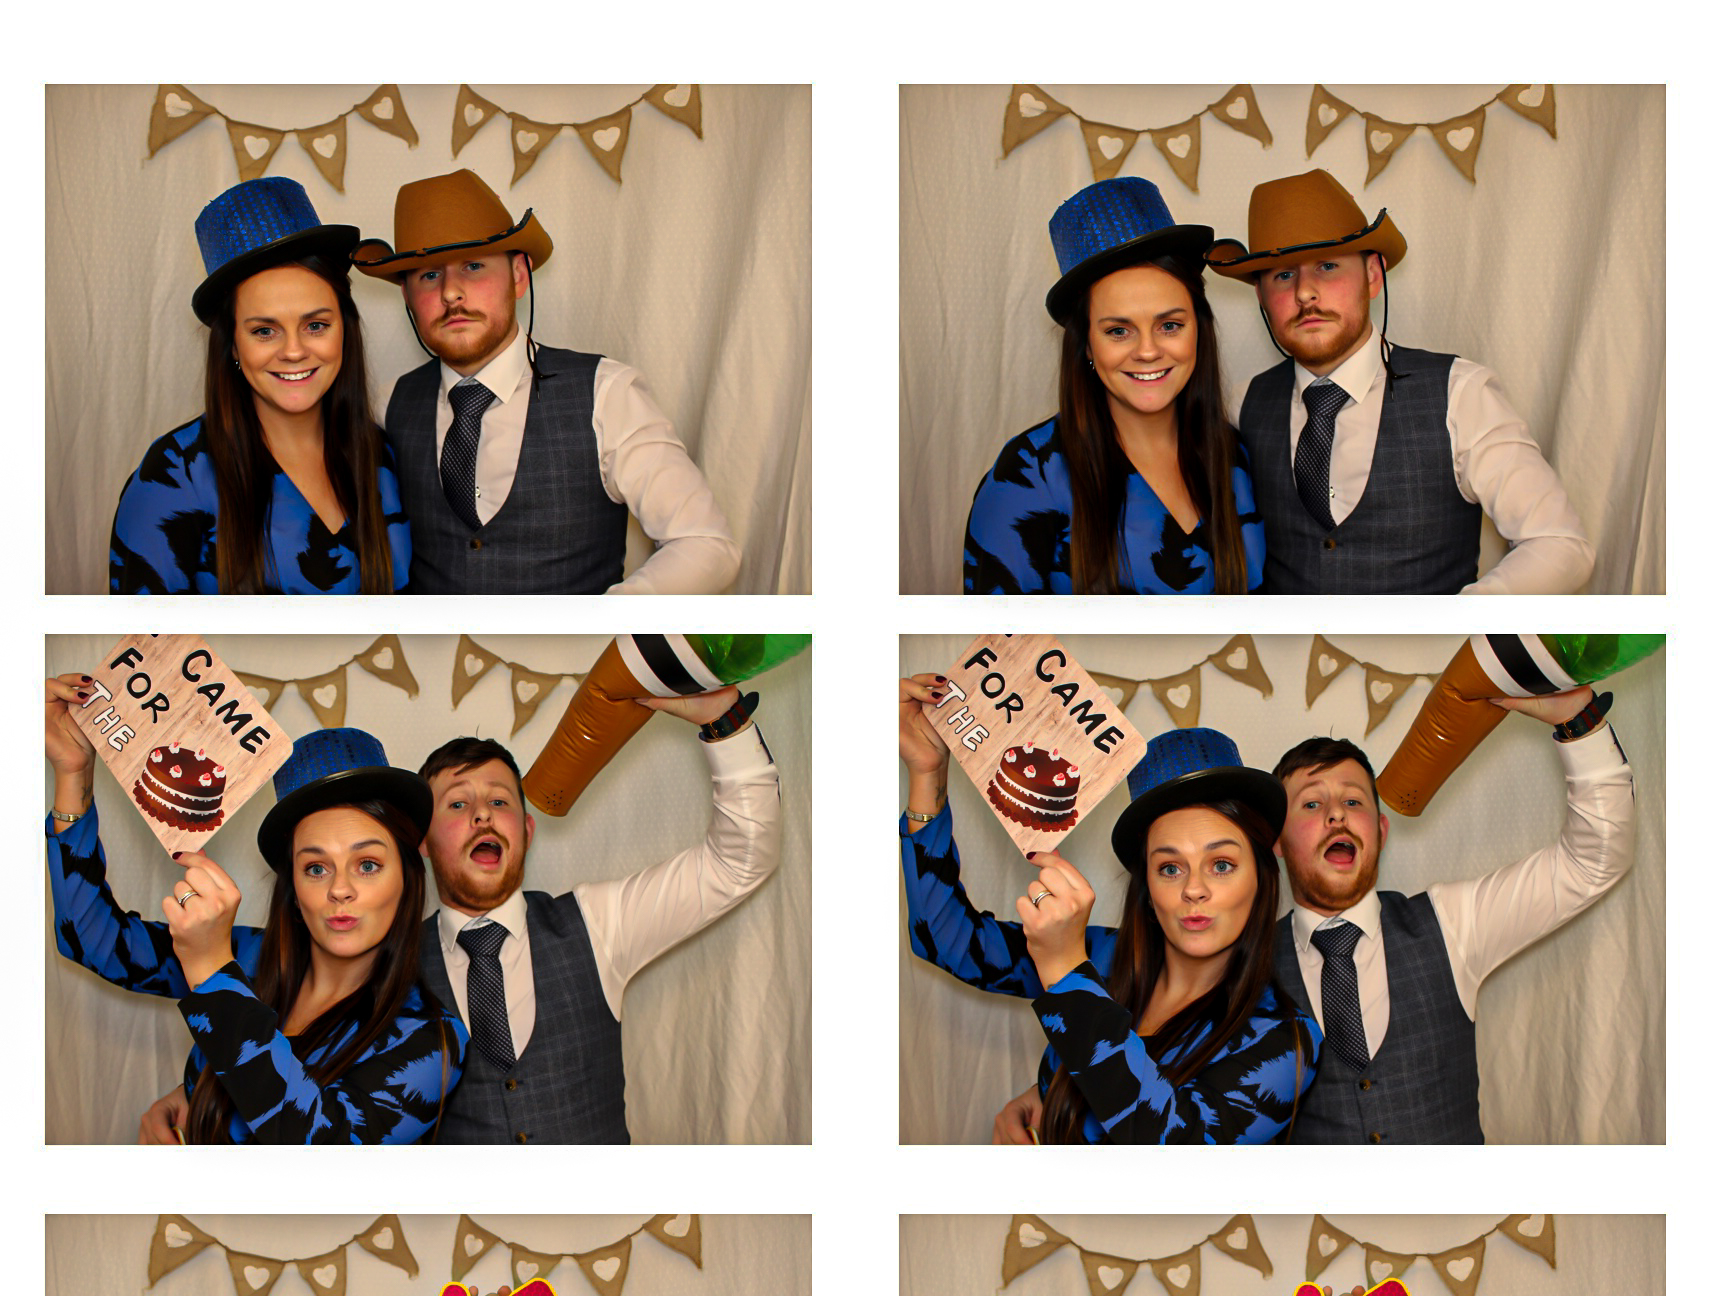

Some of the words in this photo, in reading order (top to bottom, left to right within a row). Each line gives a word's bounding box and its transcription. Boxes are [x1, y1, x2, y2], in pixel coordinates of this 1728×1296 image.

[82, 680, 136, 752] THE
[110, 647, 170, 724] FOR
[181, 649, 271, 754] CAME
[936, 680, 990, 752] THE
[964, 647, 1024, 724] FOR
[1035, 649, 1125, 754] CAME
